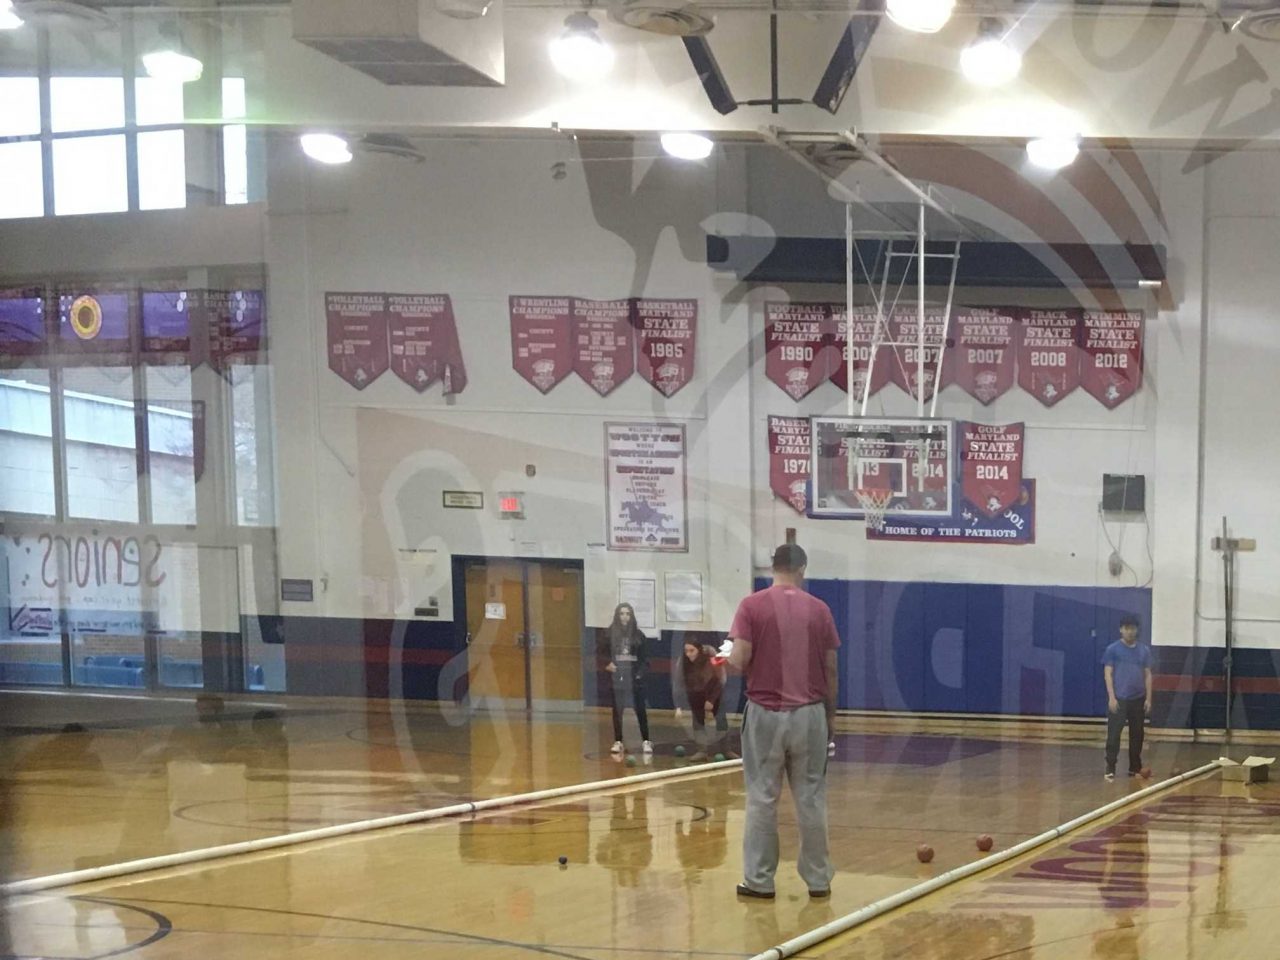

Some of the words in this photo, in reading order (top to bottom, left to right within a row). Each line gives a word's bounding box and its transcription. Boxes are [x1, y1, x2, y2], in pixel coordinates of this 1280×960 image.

[574, 300, 630, 309] BASEBALL
[637, 302, 694, 310] BASKETBALL
[768, 305, 825, 313] FOOTBALL
[513, 307, 569, 315] CHAMPIONS
[1030, 311, 1067, 319] TRACK
[769, 313, 824, 321] MARYLAND
[958, 316, 1013, 324] MARYLAND
[1083, 312, 1141, 321] SWIMMING
[644, 319, 688, 329] STATE
[774, 321, 819, 332] STATE
[1021, 318, 1077, 326] MARYLAND
[1084, 320, 1140, 328] MARYLAND
[641, 330, 692, 338] FINALIST
[963, 325, 1008, 335] STATE
[1026, 327, 1071, 338] STATE
[1090, 329, 1135, 339] STATE
[771, 332, 822, 341] FINALIST
[960, 336, 1011, 344] FINALIST
[1023, 338, 1075, 347] FINALIST
[1086, 340, 1137, 349] FINALIST
[651, 343, 683, 358] 1985
[781, 346, 813, 361] 1990
[968, 349, 1003, 364] 2007
[1031, 352, 1066, 366] 2008
[1095, 353, 1128, 368] 2012
[777, 435, 810, 445] STAT
[965, 432, 1020, 441] MARYLAND
[970, 441, 1015, 452] STATE
[967, 452, 1018, 461] FINALIST
[976, 465, 1008, 480] 2014
[885, 527, 917, 535] HOME
[938, 528, 961, 536] THE
[964, 528, 1017, 537] PATRIOTS
